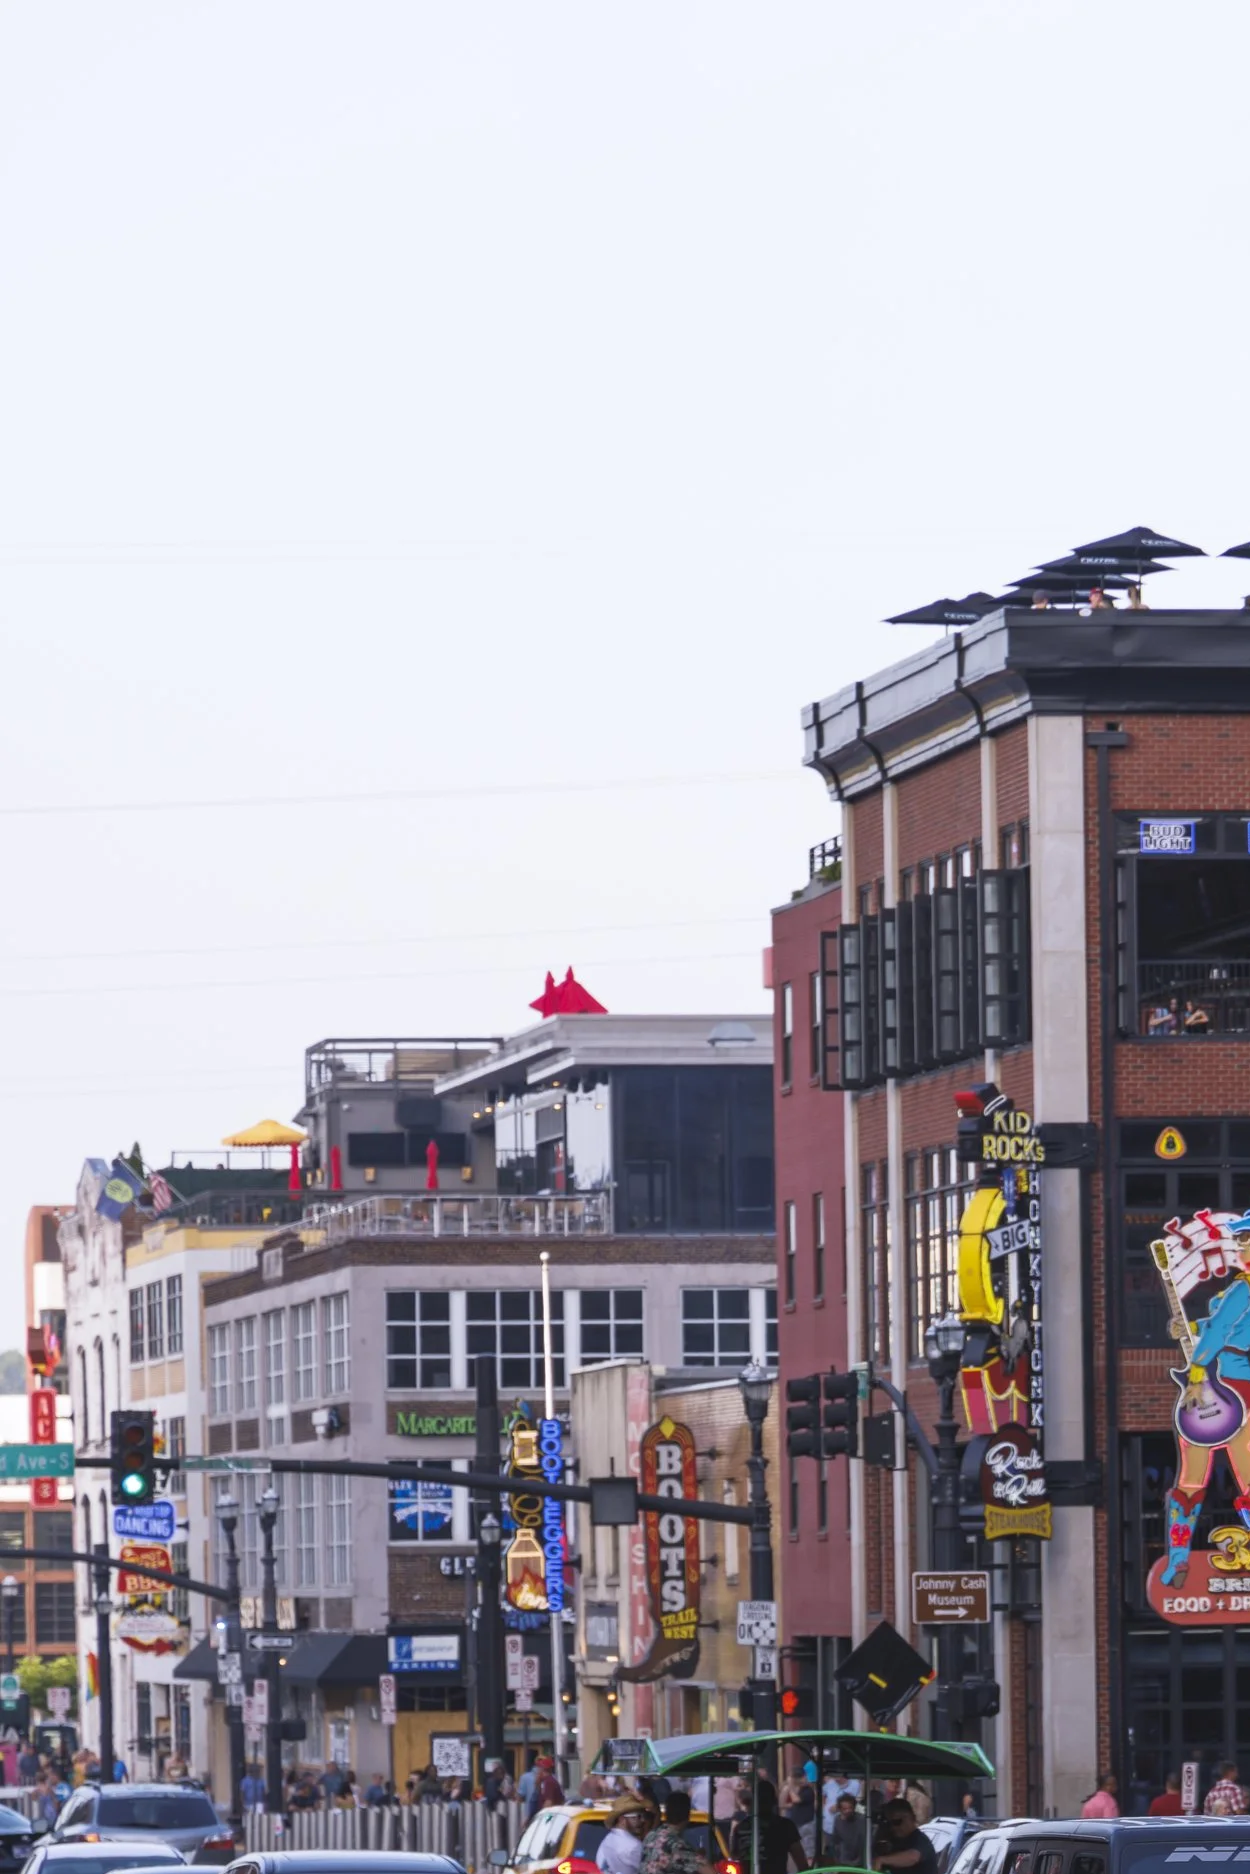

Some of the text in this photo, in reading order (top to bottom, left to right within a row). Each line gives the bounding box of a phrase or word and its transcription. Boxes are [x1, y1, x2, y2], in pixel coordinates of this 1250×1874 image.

[1149, 825, 1185, 837] BUD
[1143, 836, 1192, 850] LIGHT
[993, 1111, 1031, 1134] KID
[1001, 1223, 1027, 1252] BIG
[115, 1515, 171, 1537] DANCING
[654, 1444, 687, 1613] BOOTS
[916, 1576, 986, 1593] Johnny Cash
[928, 1593, 975, 1606] Museum
[1163, 1597, 1211, 1613] FOOD
[663, 1624, 695, 1640] WEST
[738, 1623, 754, 1640] OK
